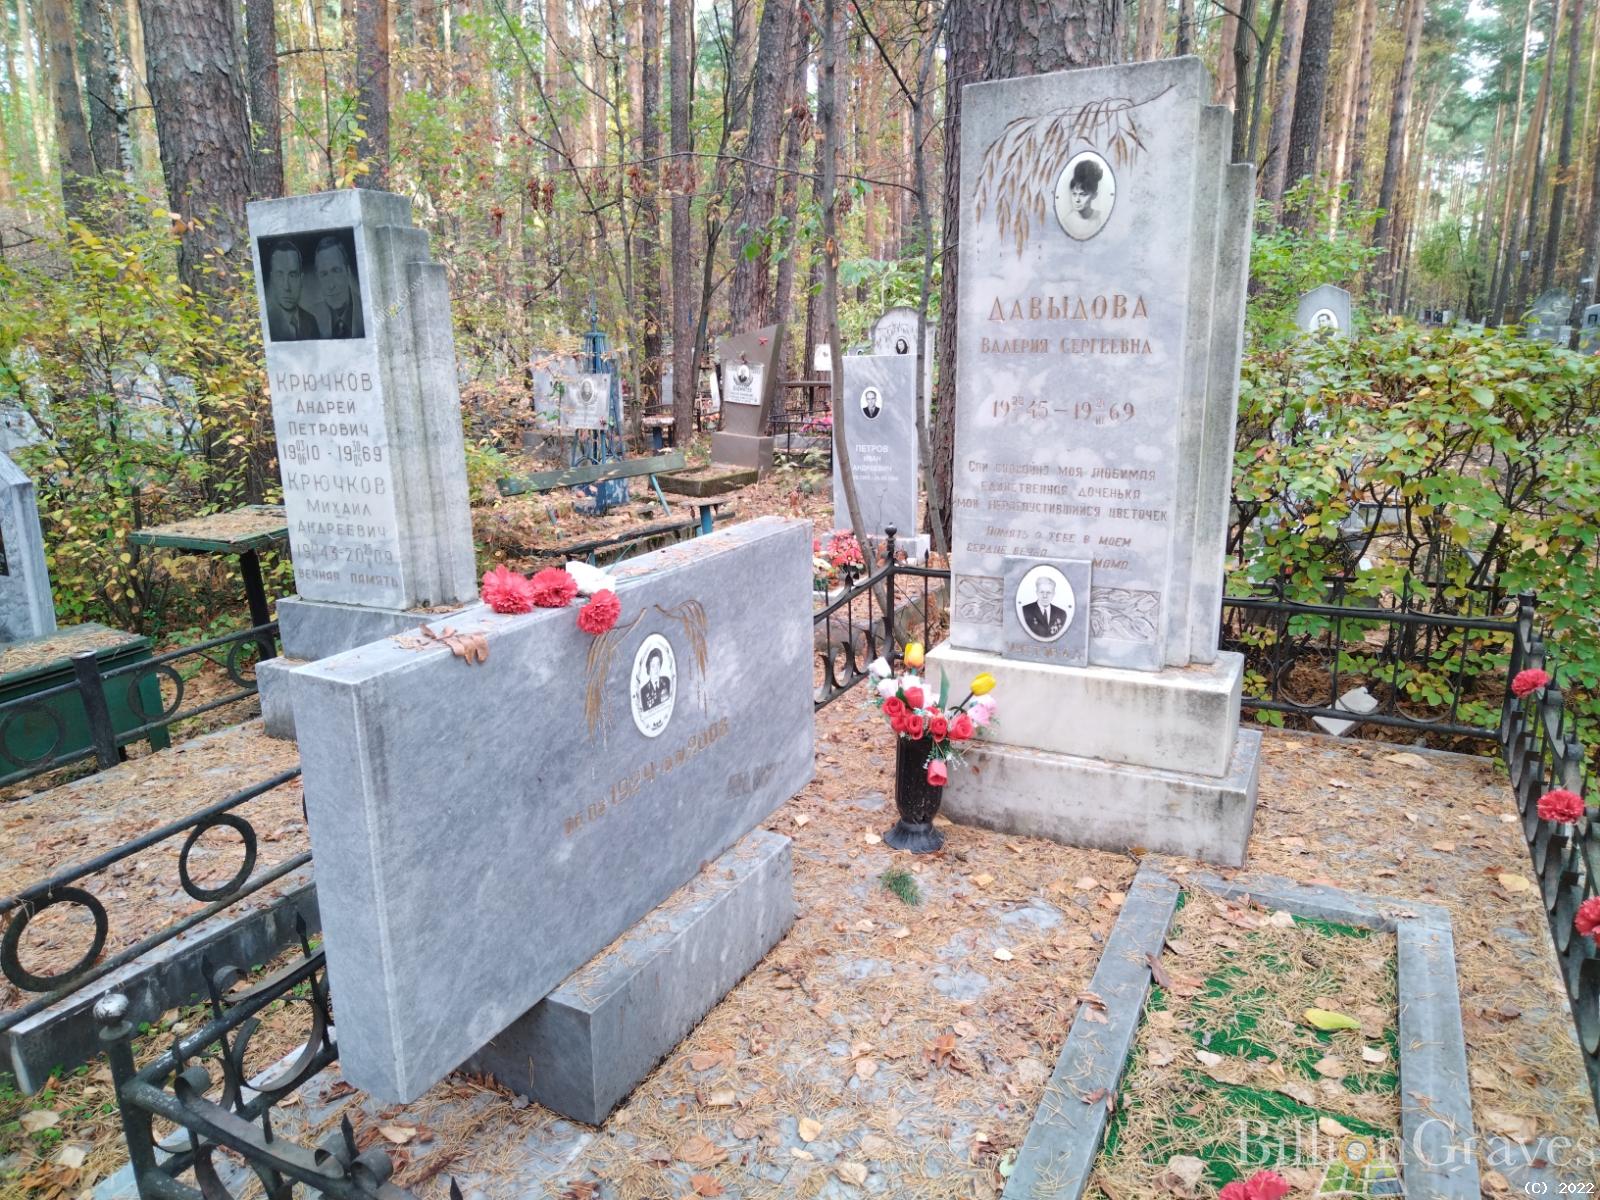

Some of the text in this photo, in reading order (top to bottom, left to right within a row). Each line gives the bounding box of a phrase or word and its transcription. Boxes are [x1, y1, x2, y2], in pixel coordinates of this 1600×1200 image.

[988, 294, 1149, 322] ДАВЫДОВА
[275, 371, 374, 393] КРЮЧКОВ
[296, 399, 357, 415] АНДРЕЙ
[288, 420, 370, 437] ПЕТРОВИЧ
[287, 472, 387, 495] КРЮЧКОВ
